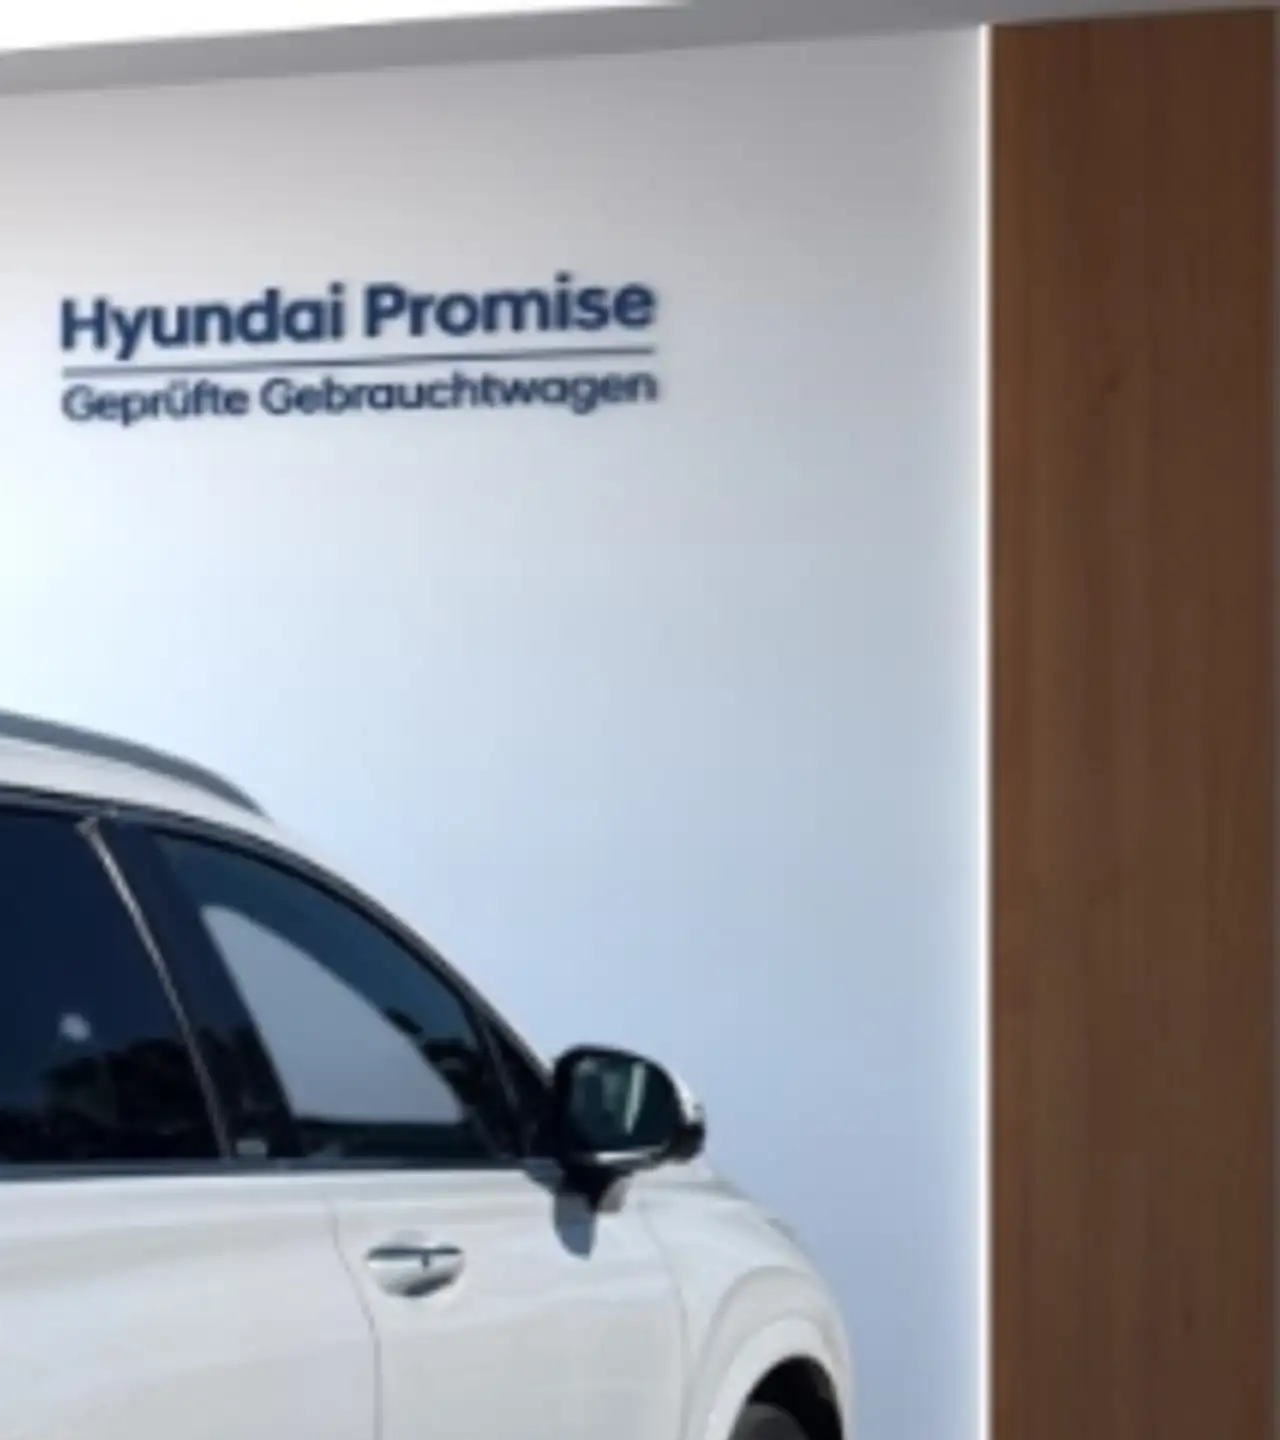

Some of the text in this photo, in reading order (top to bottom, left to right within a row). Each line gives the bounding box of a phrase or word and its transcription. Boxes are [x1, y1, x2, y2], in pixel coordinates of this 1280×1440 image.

[60, 271, 658, 361] Hyundai Promise
[61, 368, 659, 427] Geprüfte Gebrauchtwagen
